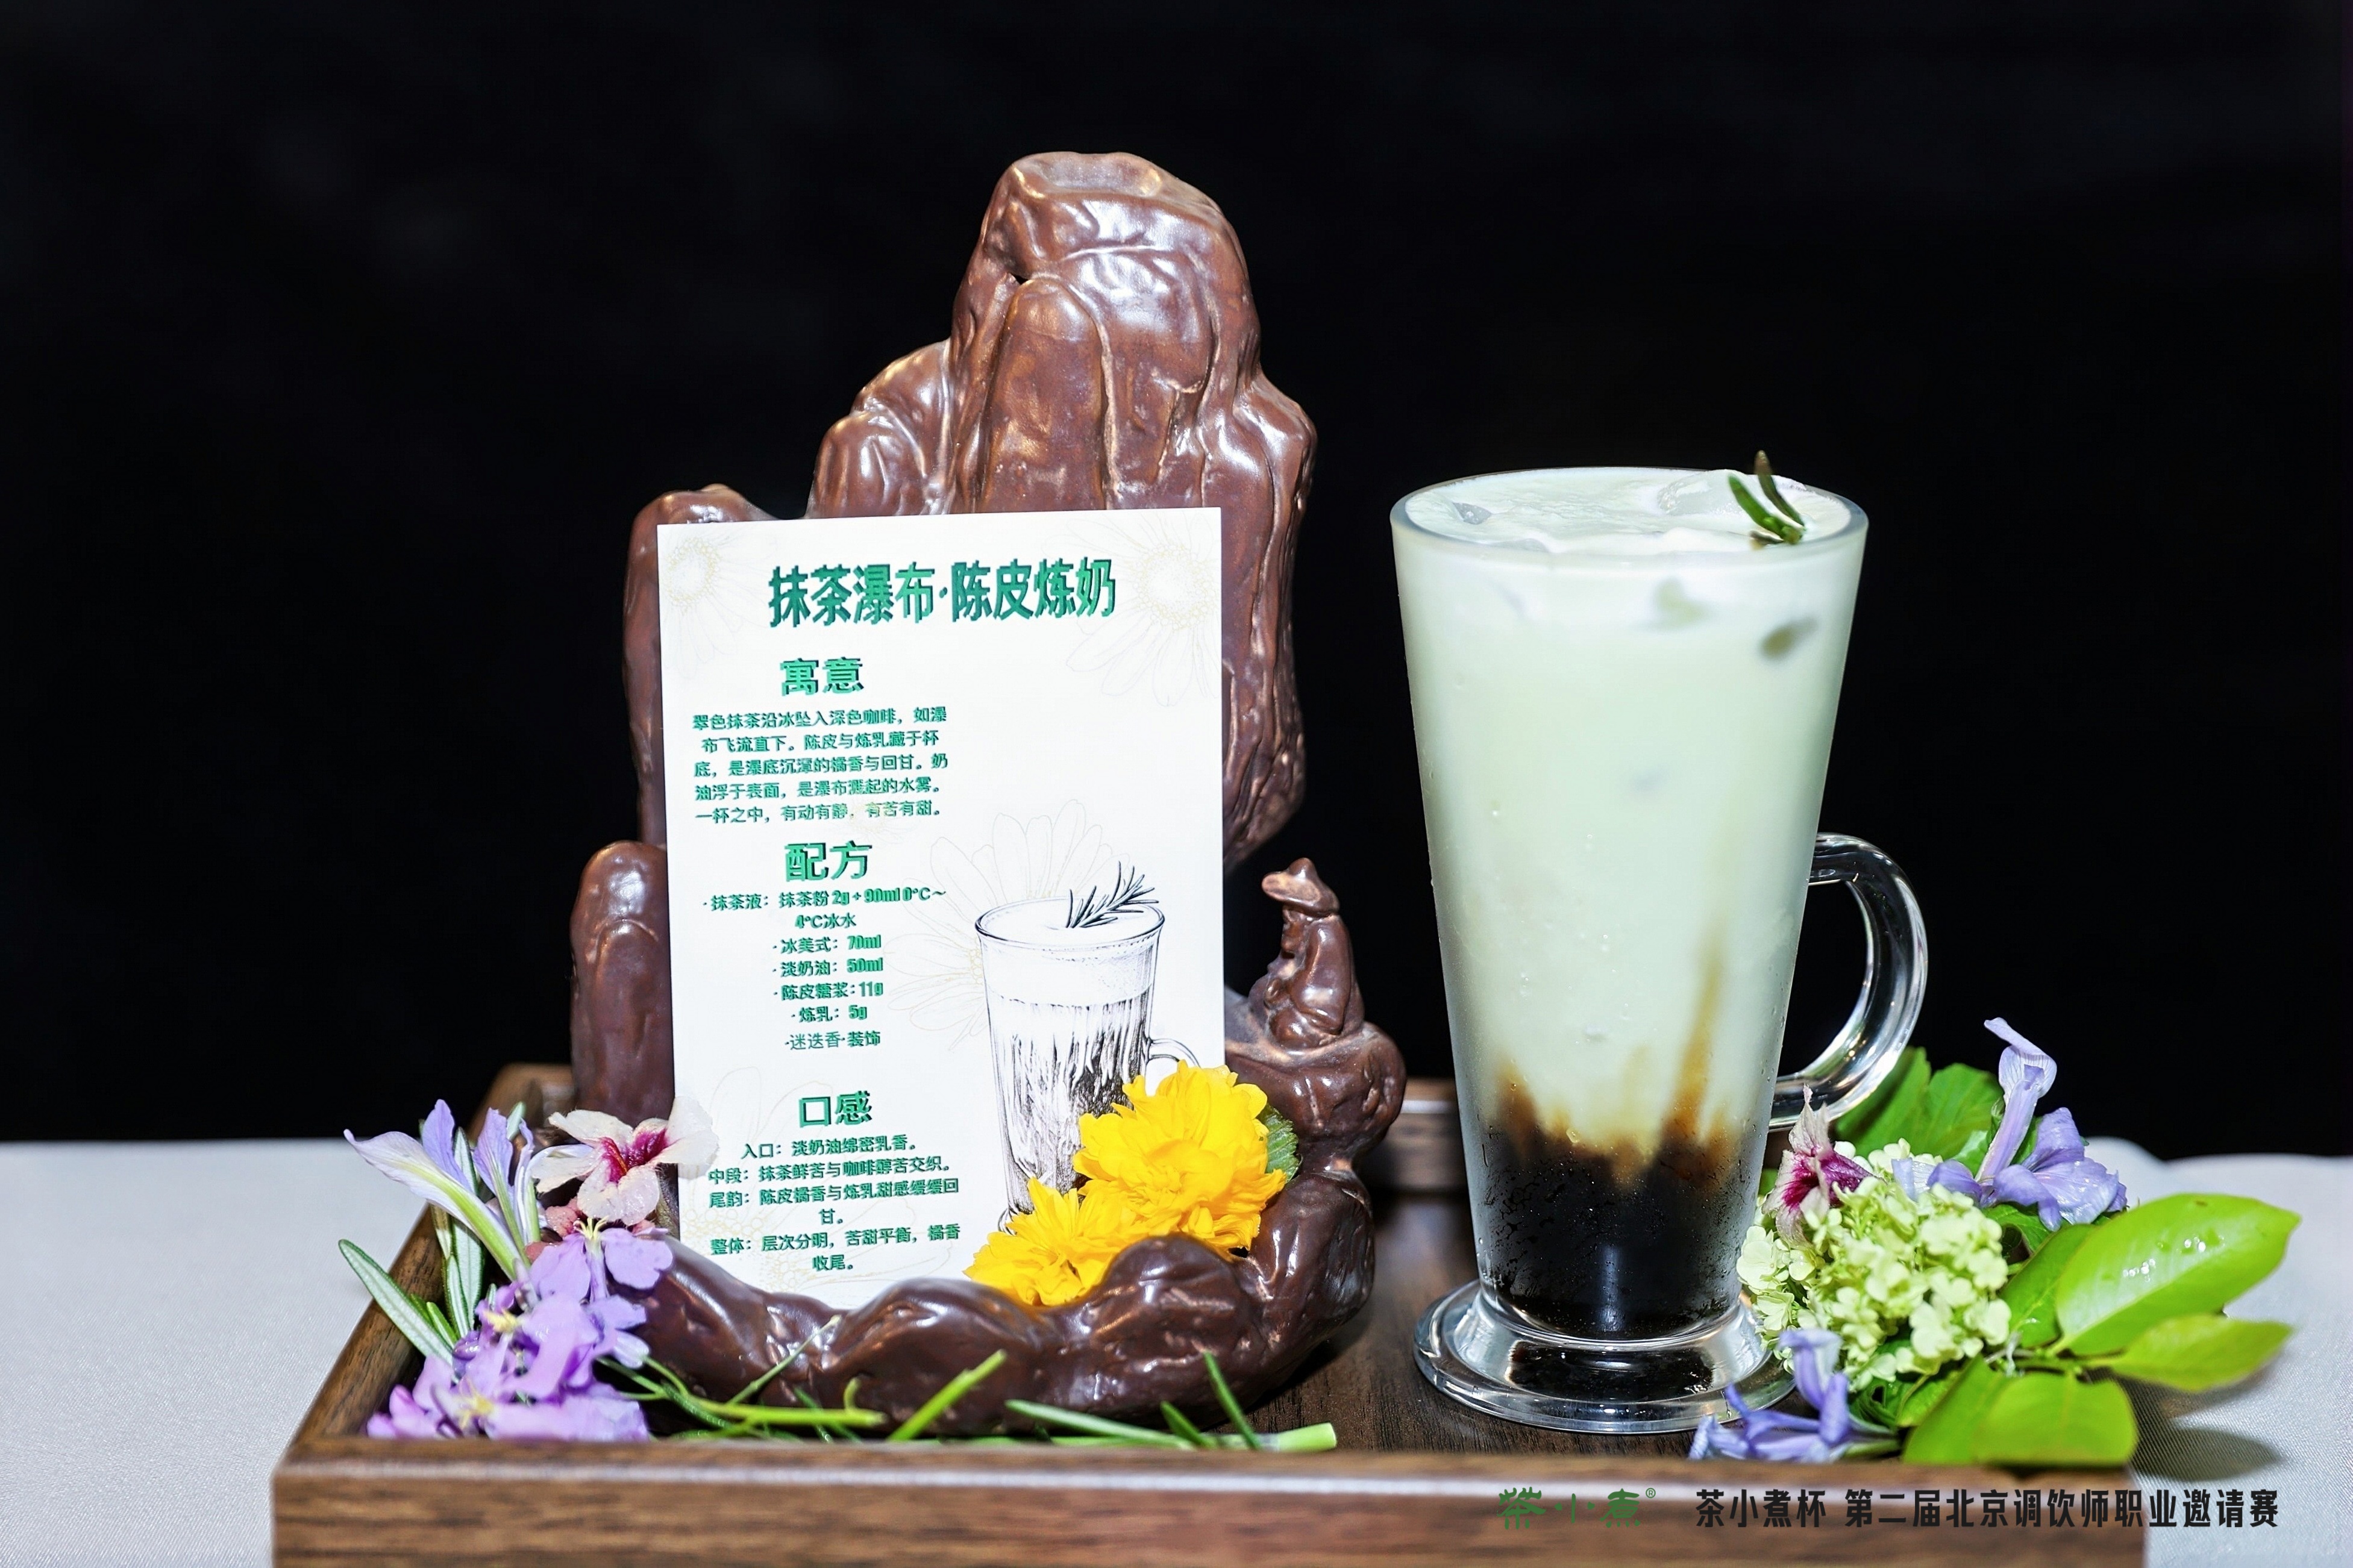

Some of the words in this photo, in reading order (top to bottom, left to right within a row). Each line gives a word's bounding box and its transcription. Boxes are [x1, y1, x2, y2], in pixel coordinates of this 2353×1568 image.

[768, 556, 1116, 628] 抹茶瀑布·陈皮炼奶
[780, 656, 865, 696] 寓意
[693, 706, 947, 731] 翠色抹茶沿冰坠入深色咖啡，如瀑
[702, 729, 939, 753] 布飞流直下。陈皮与炼乳藏于杯
[785, 840, 873, 882] 配方
[832, 890, 850, 906] 2g
[863, 887, 901, 904] 90ml
[798, 1090, 873, 1128] 口感
[818, 1208, 844, 1225] 甘。
[812, 1254, 853, 1272] 收尾。
